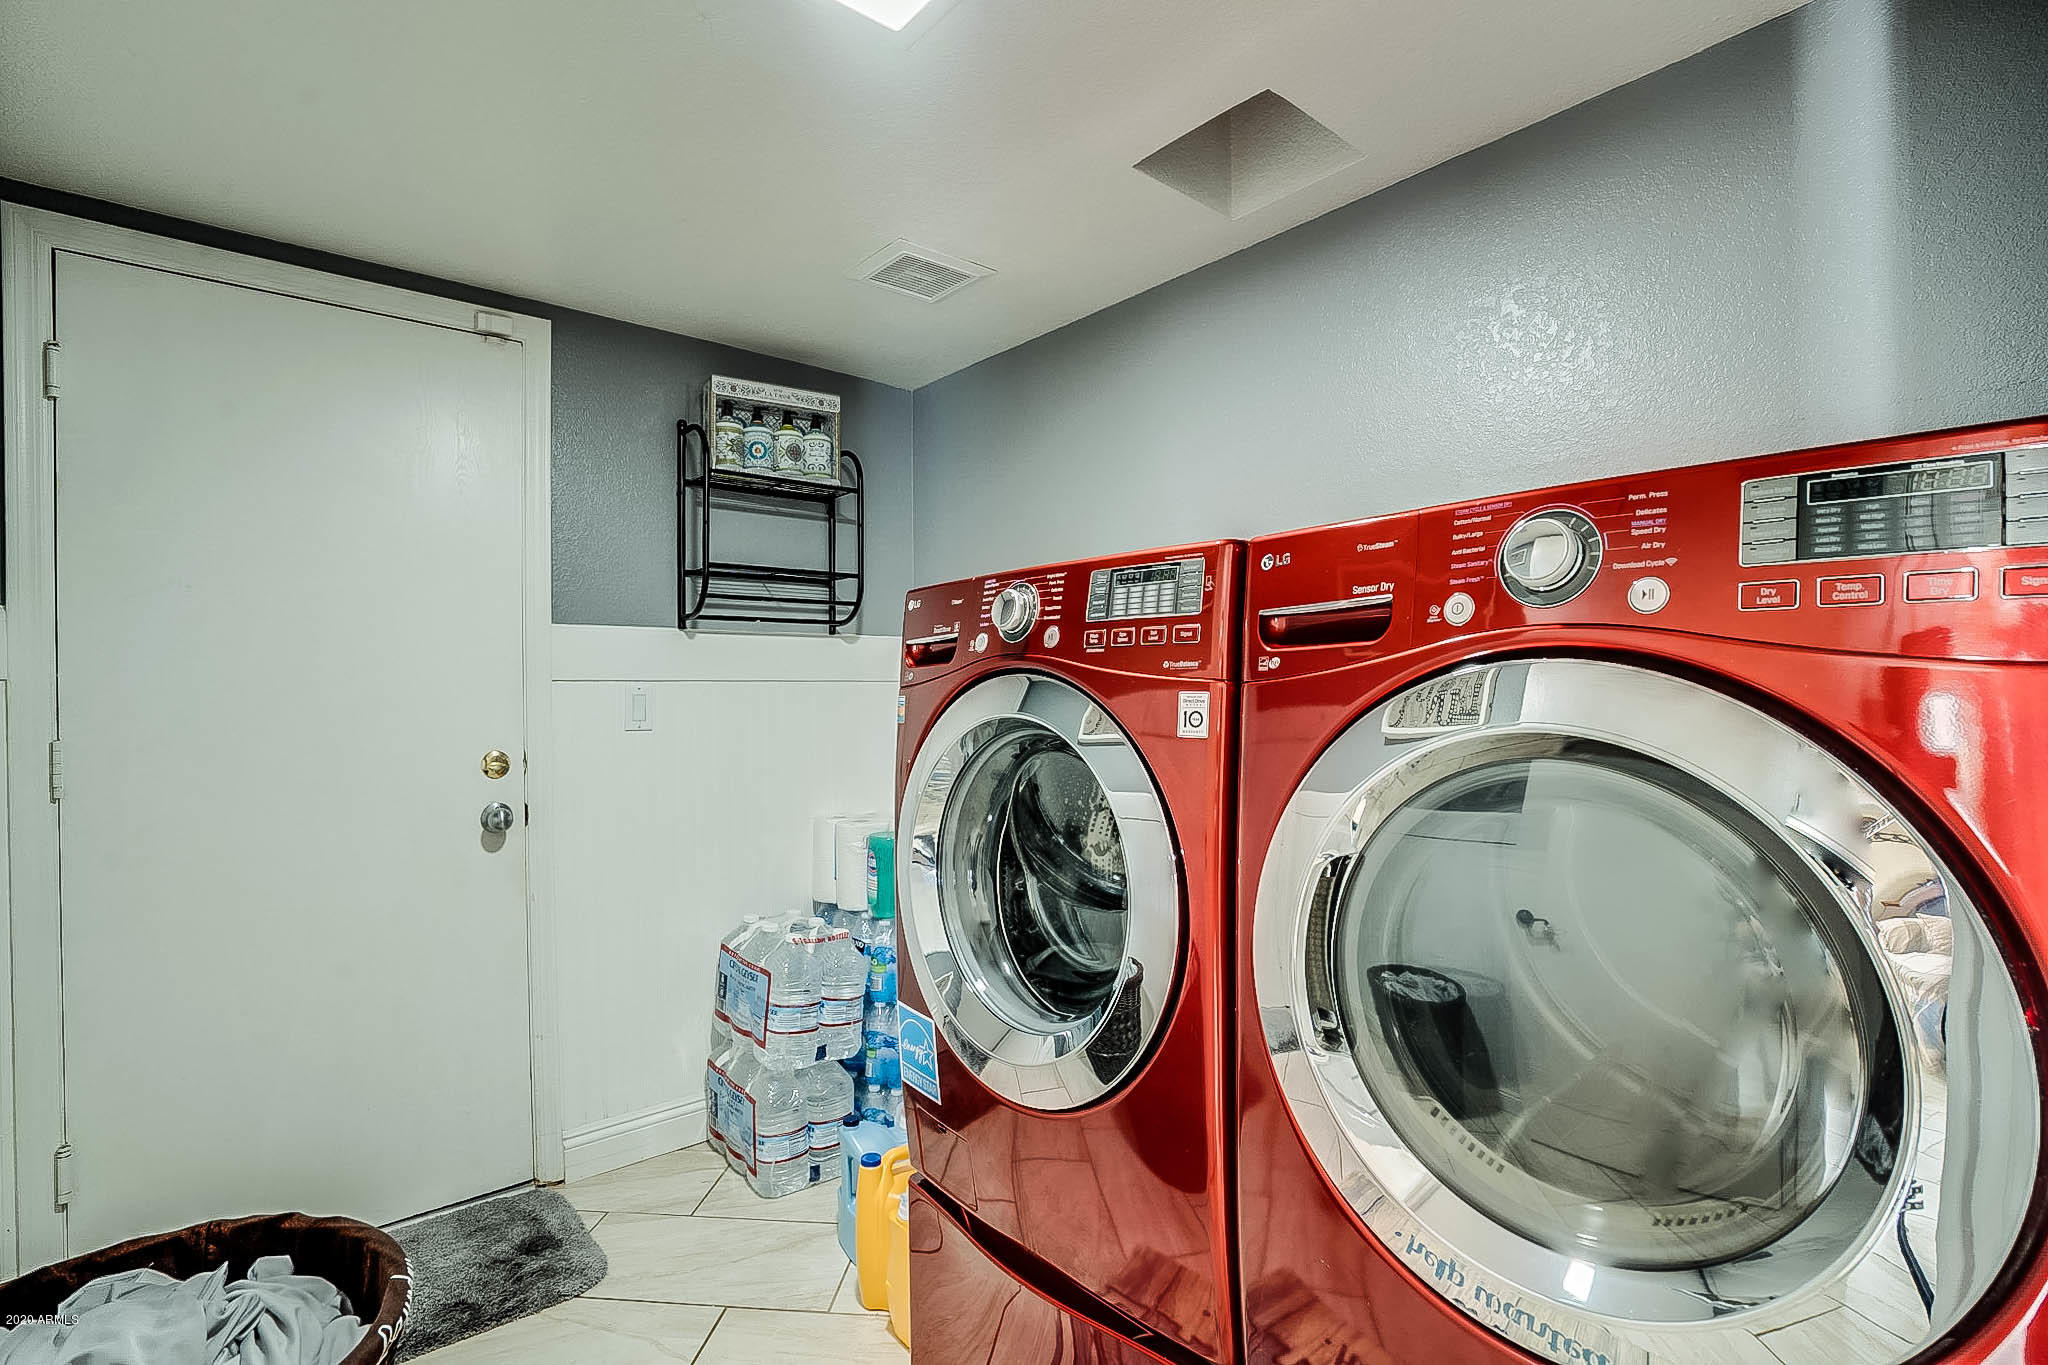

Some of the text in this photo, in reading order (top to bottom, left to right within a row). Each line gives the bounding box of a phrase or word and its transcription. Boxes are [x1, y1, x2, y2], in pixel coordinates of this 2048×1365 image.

[1635, 507, 1668, 517] Delicates
[1653, 526, 1667, 534] Dry
[1640, 541, 1666, 550] Air Dry
[1275, 552, 1291, 567] LG
[1352, 581, 1395, 595] Sensor Dry
[1760, 587, 1777, 597] Dry
[1756, 595, 1781, 605] Level
[1832, 590, 1868, 601] Control
[1183, 710, 1204, 728] 10
